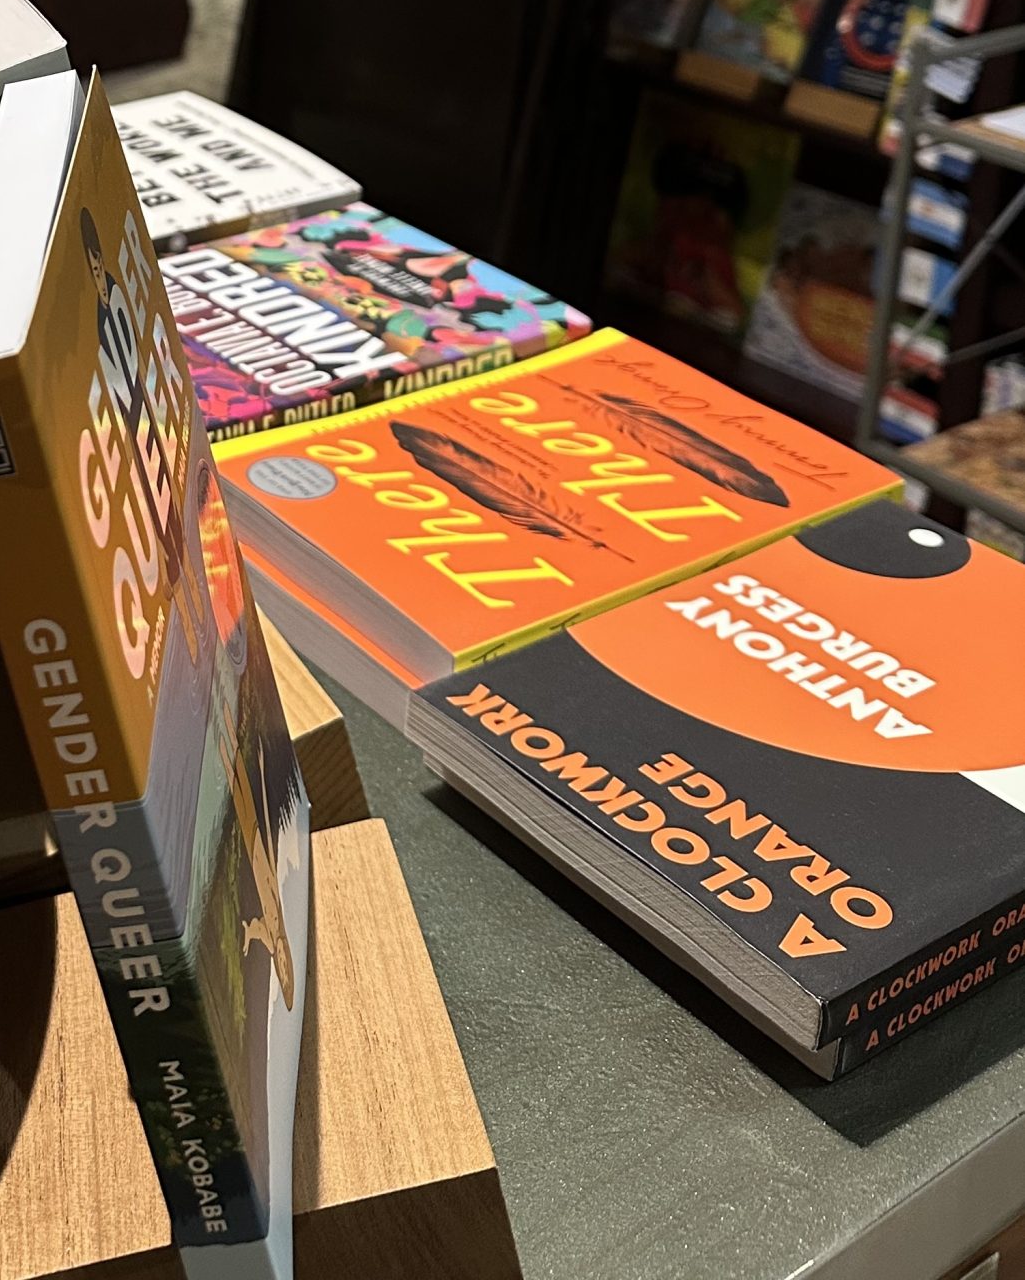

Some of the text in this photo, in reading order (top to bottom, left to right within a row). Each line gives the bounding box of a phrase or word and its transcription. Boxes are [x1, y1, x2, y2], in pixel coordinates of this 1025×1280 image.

[79, 209, 152, 548] GENDER
[157, 248, 408, 381] KINDRED
[195, 320, 332, 396] OCTAVIA
[113, 312, 183, 681] QUEER
[305, 438, 574, 610] There
[469, 391, 743, 543] There
[665, 596, 933, 740] ANTHONY
[712, 573, 937, 698] BURGESS
[24, 618, 170, 1016] GENDER QUEER
[445, 683, 847, 958] A CLOCKWORK
[639, 751, 893, 929] ORANGE
[846, 1003, 859, 1025] A
[867, 930, 982, 1011] CLOCKWORK
[865, 957, 997, 1051] A CLOCKWORK
[159, 1060, 228, 1233] MAIA KOBABE
